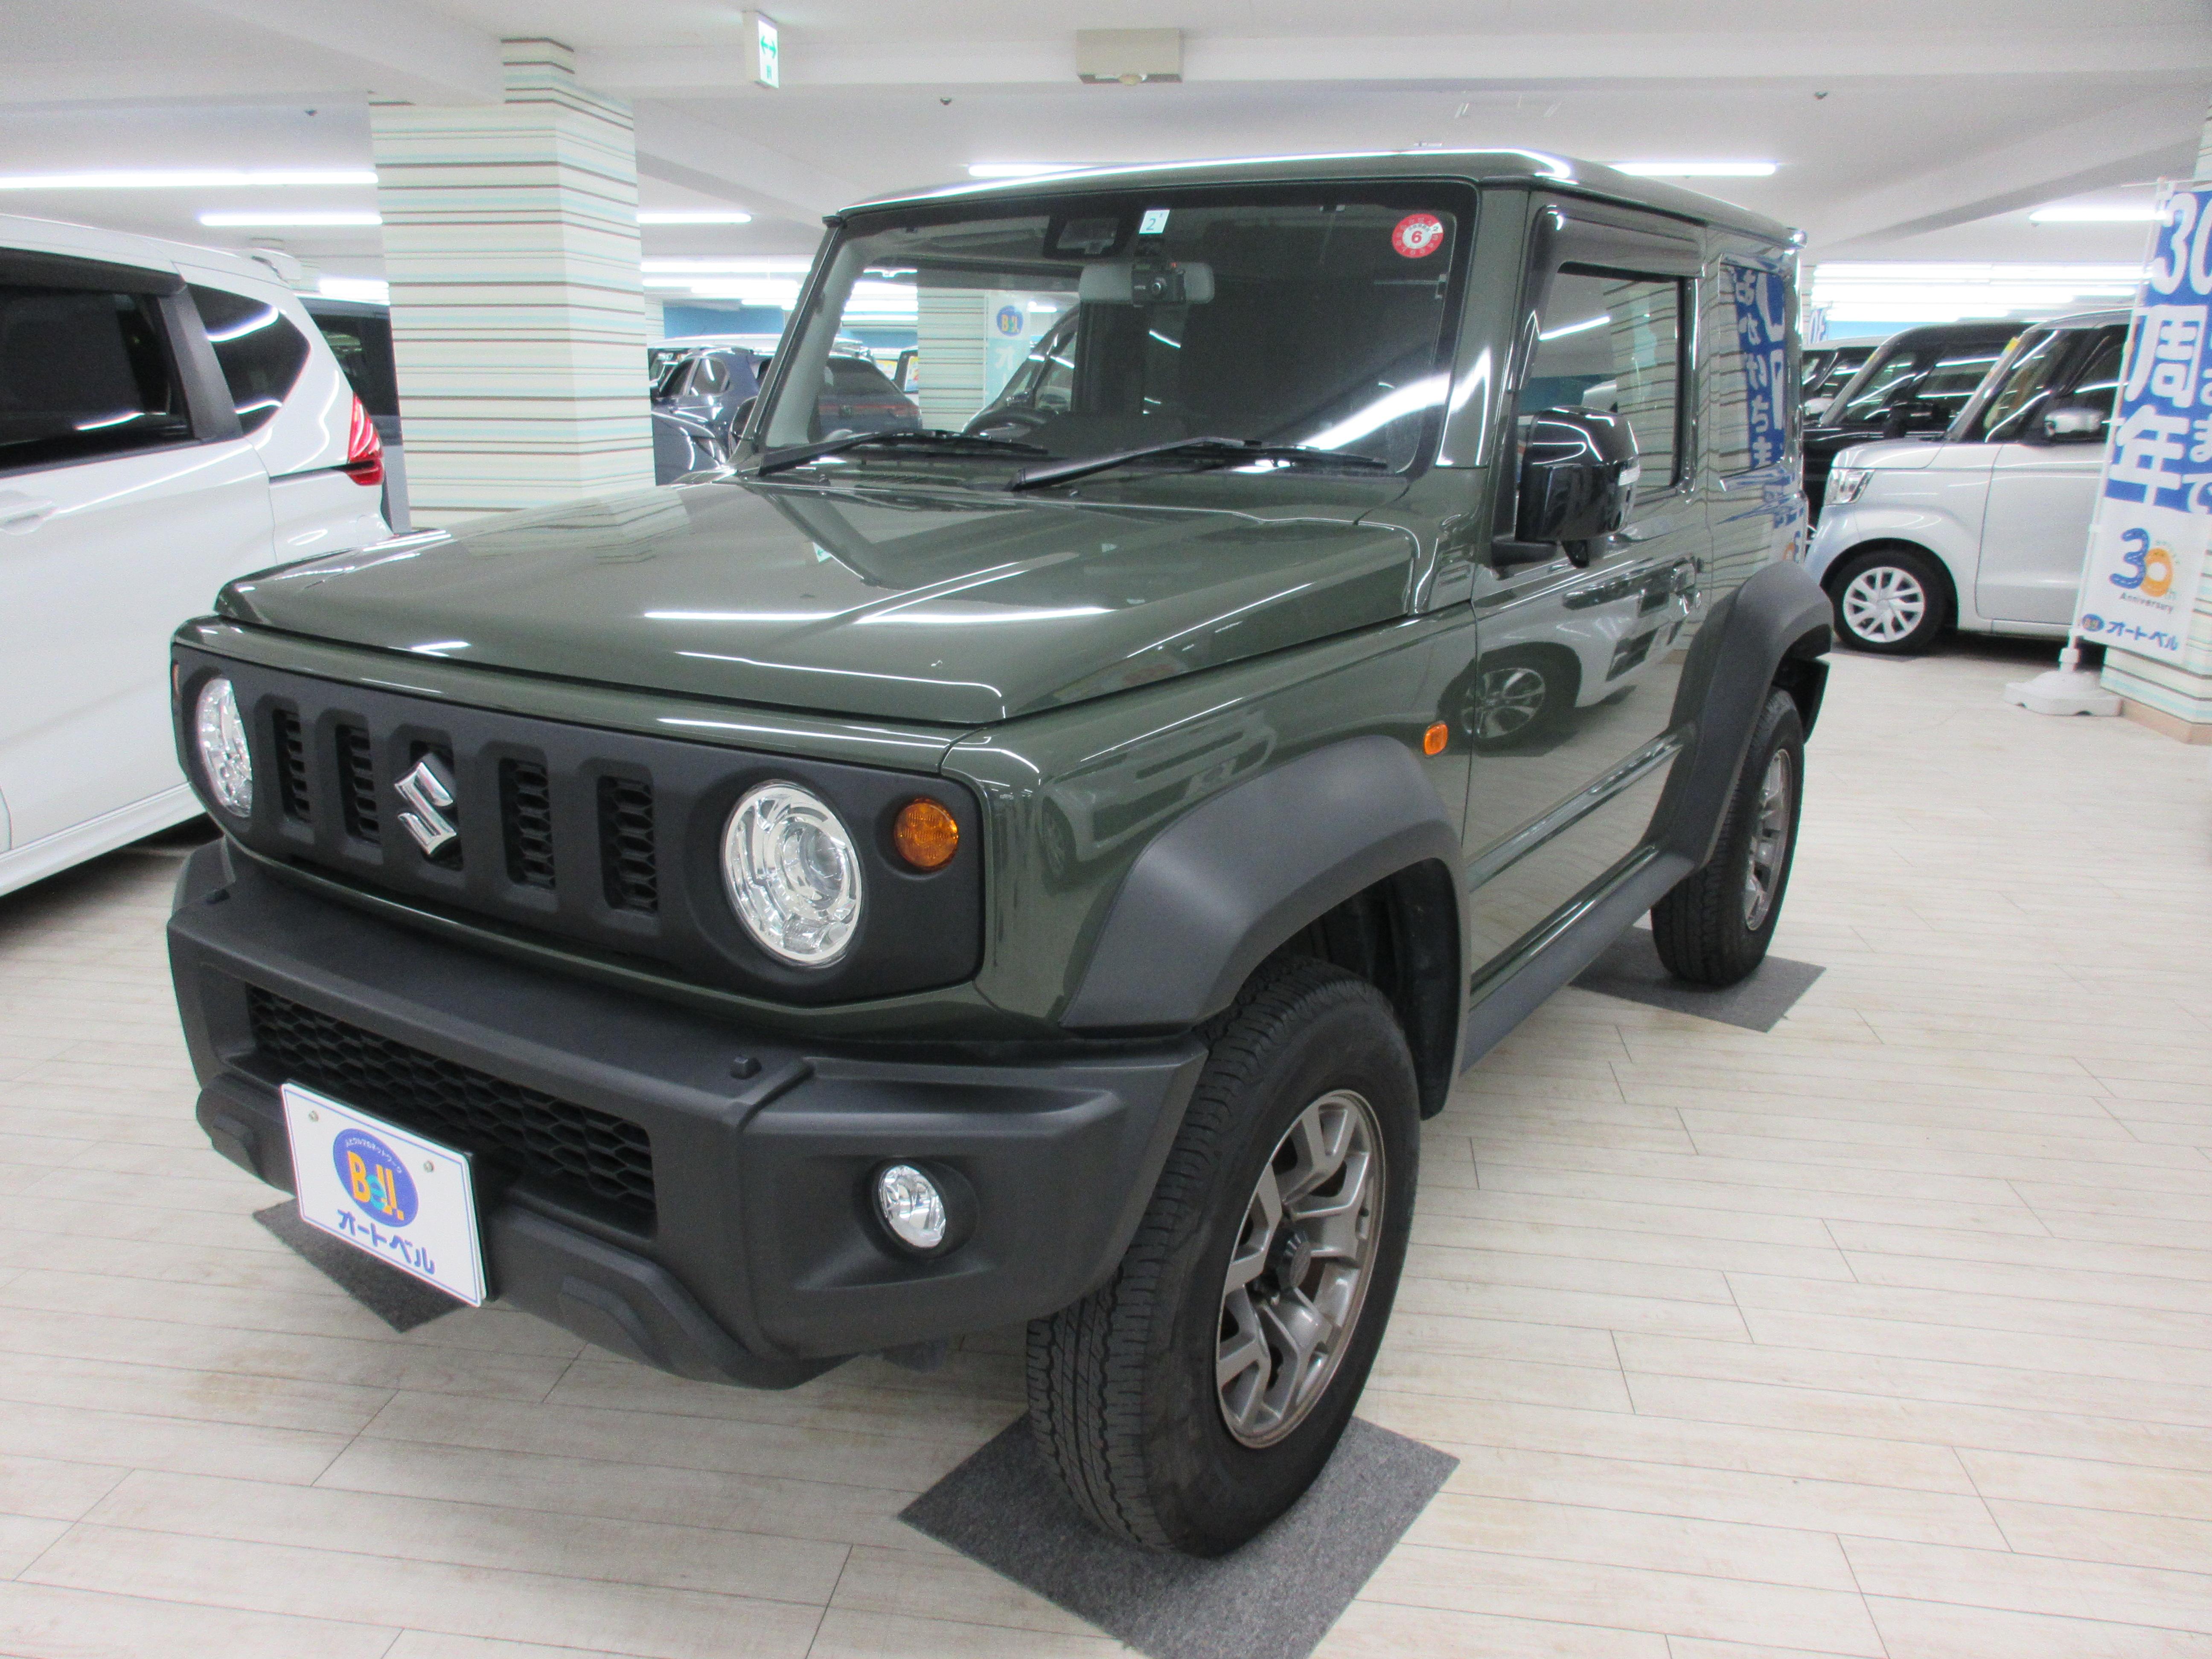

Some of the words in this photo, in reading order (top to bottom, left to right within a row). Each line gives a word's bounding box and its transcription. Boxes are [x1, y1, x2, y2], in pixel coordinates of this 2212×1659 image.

[1146, 218, 1156, 230] 2
[1412, 231, 1422, 243] 6
[2106, 620, 2179, 651] オートベル
[337, 1209, 435, 1275] オートベル
